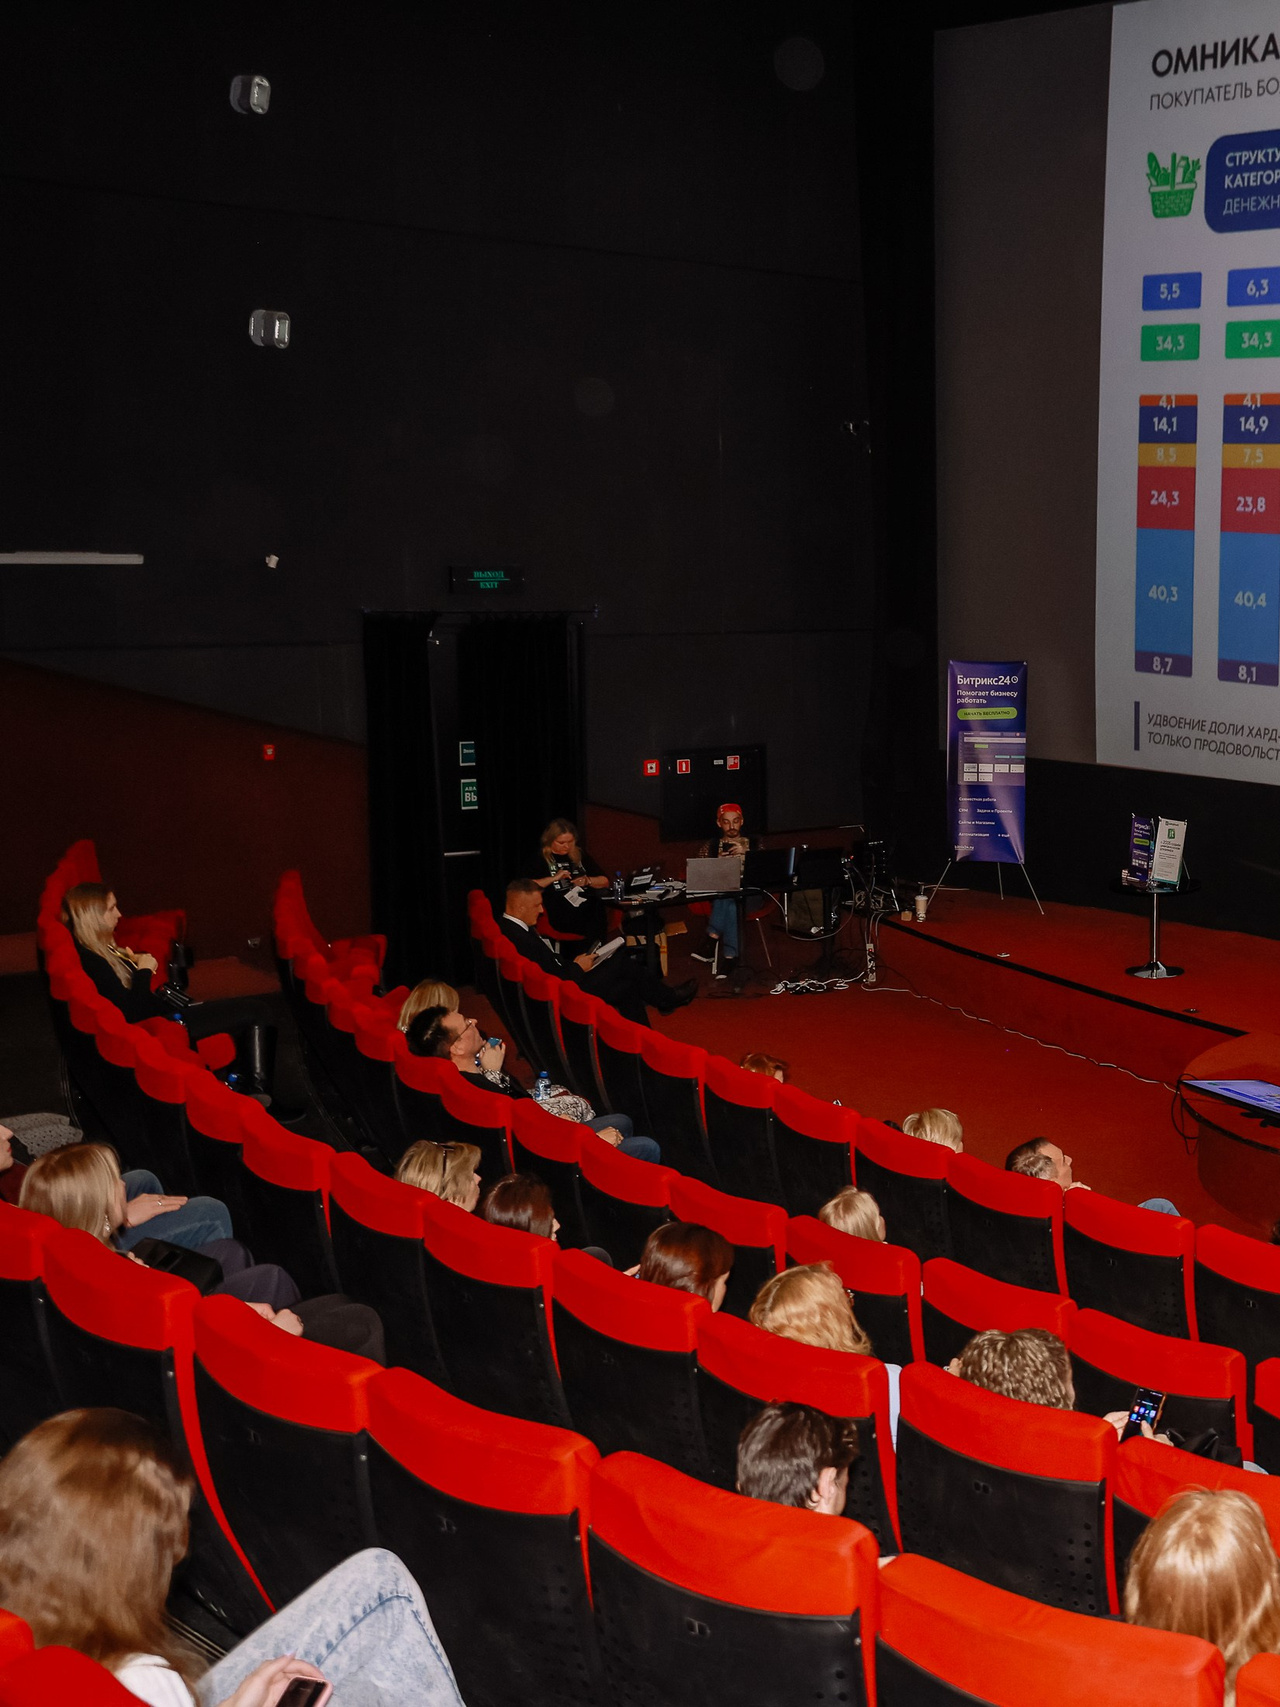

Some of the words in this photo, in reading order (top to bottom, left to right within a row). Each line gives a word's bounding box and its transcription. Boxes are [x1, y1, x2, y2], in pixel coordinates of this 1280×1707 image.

[1150, 81, 1252, 111] ПОКУПАТЕЛЬ
[1159, 282, 1181, 302] 5,5
[1246, 278, 1269, 298] 6,3
[1155, 334, 1186, 353] 34,3
[1241, 331, 1273, 350] 34,3
[1159, 394, 1176, 410] 4,1
[1243, 393, 1261, 410] 4,1
[1153, 416, 1177, 433] 14,1
[1239, 416, 1269, 435] 14,9
[1243, 448, 1264, 465] 7,5
[1150, 490, 1180, 507] 24,3
[1236, 496, 1266, 515] 23,8
[1148, 584, 1178, 603] 40,3
[1234, 591, 1266, 609] 40,4
[1153, 656, 1173, 675] 8,7
[1238, 665, 1256, 684] 8,1
[957, 674, 1010, 688] Битрикс24
[956, 689, 988, 697] Помогает
[990, 690, 1018, 698] бизнесу
[1147, 712, 1207, 733] УДВОЕНИЕ
[1208, 720, 1245, 738] ДОЛИ
[1147, 731, 1192, 749] ТОЛЬКО
